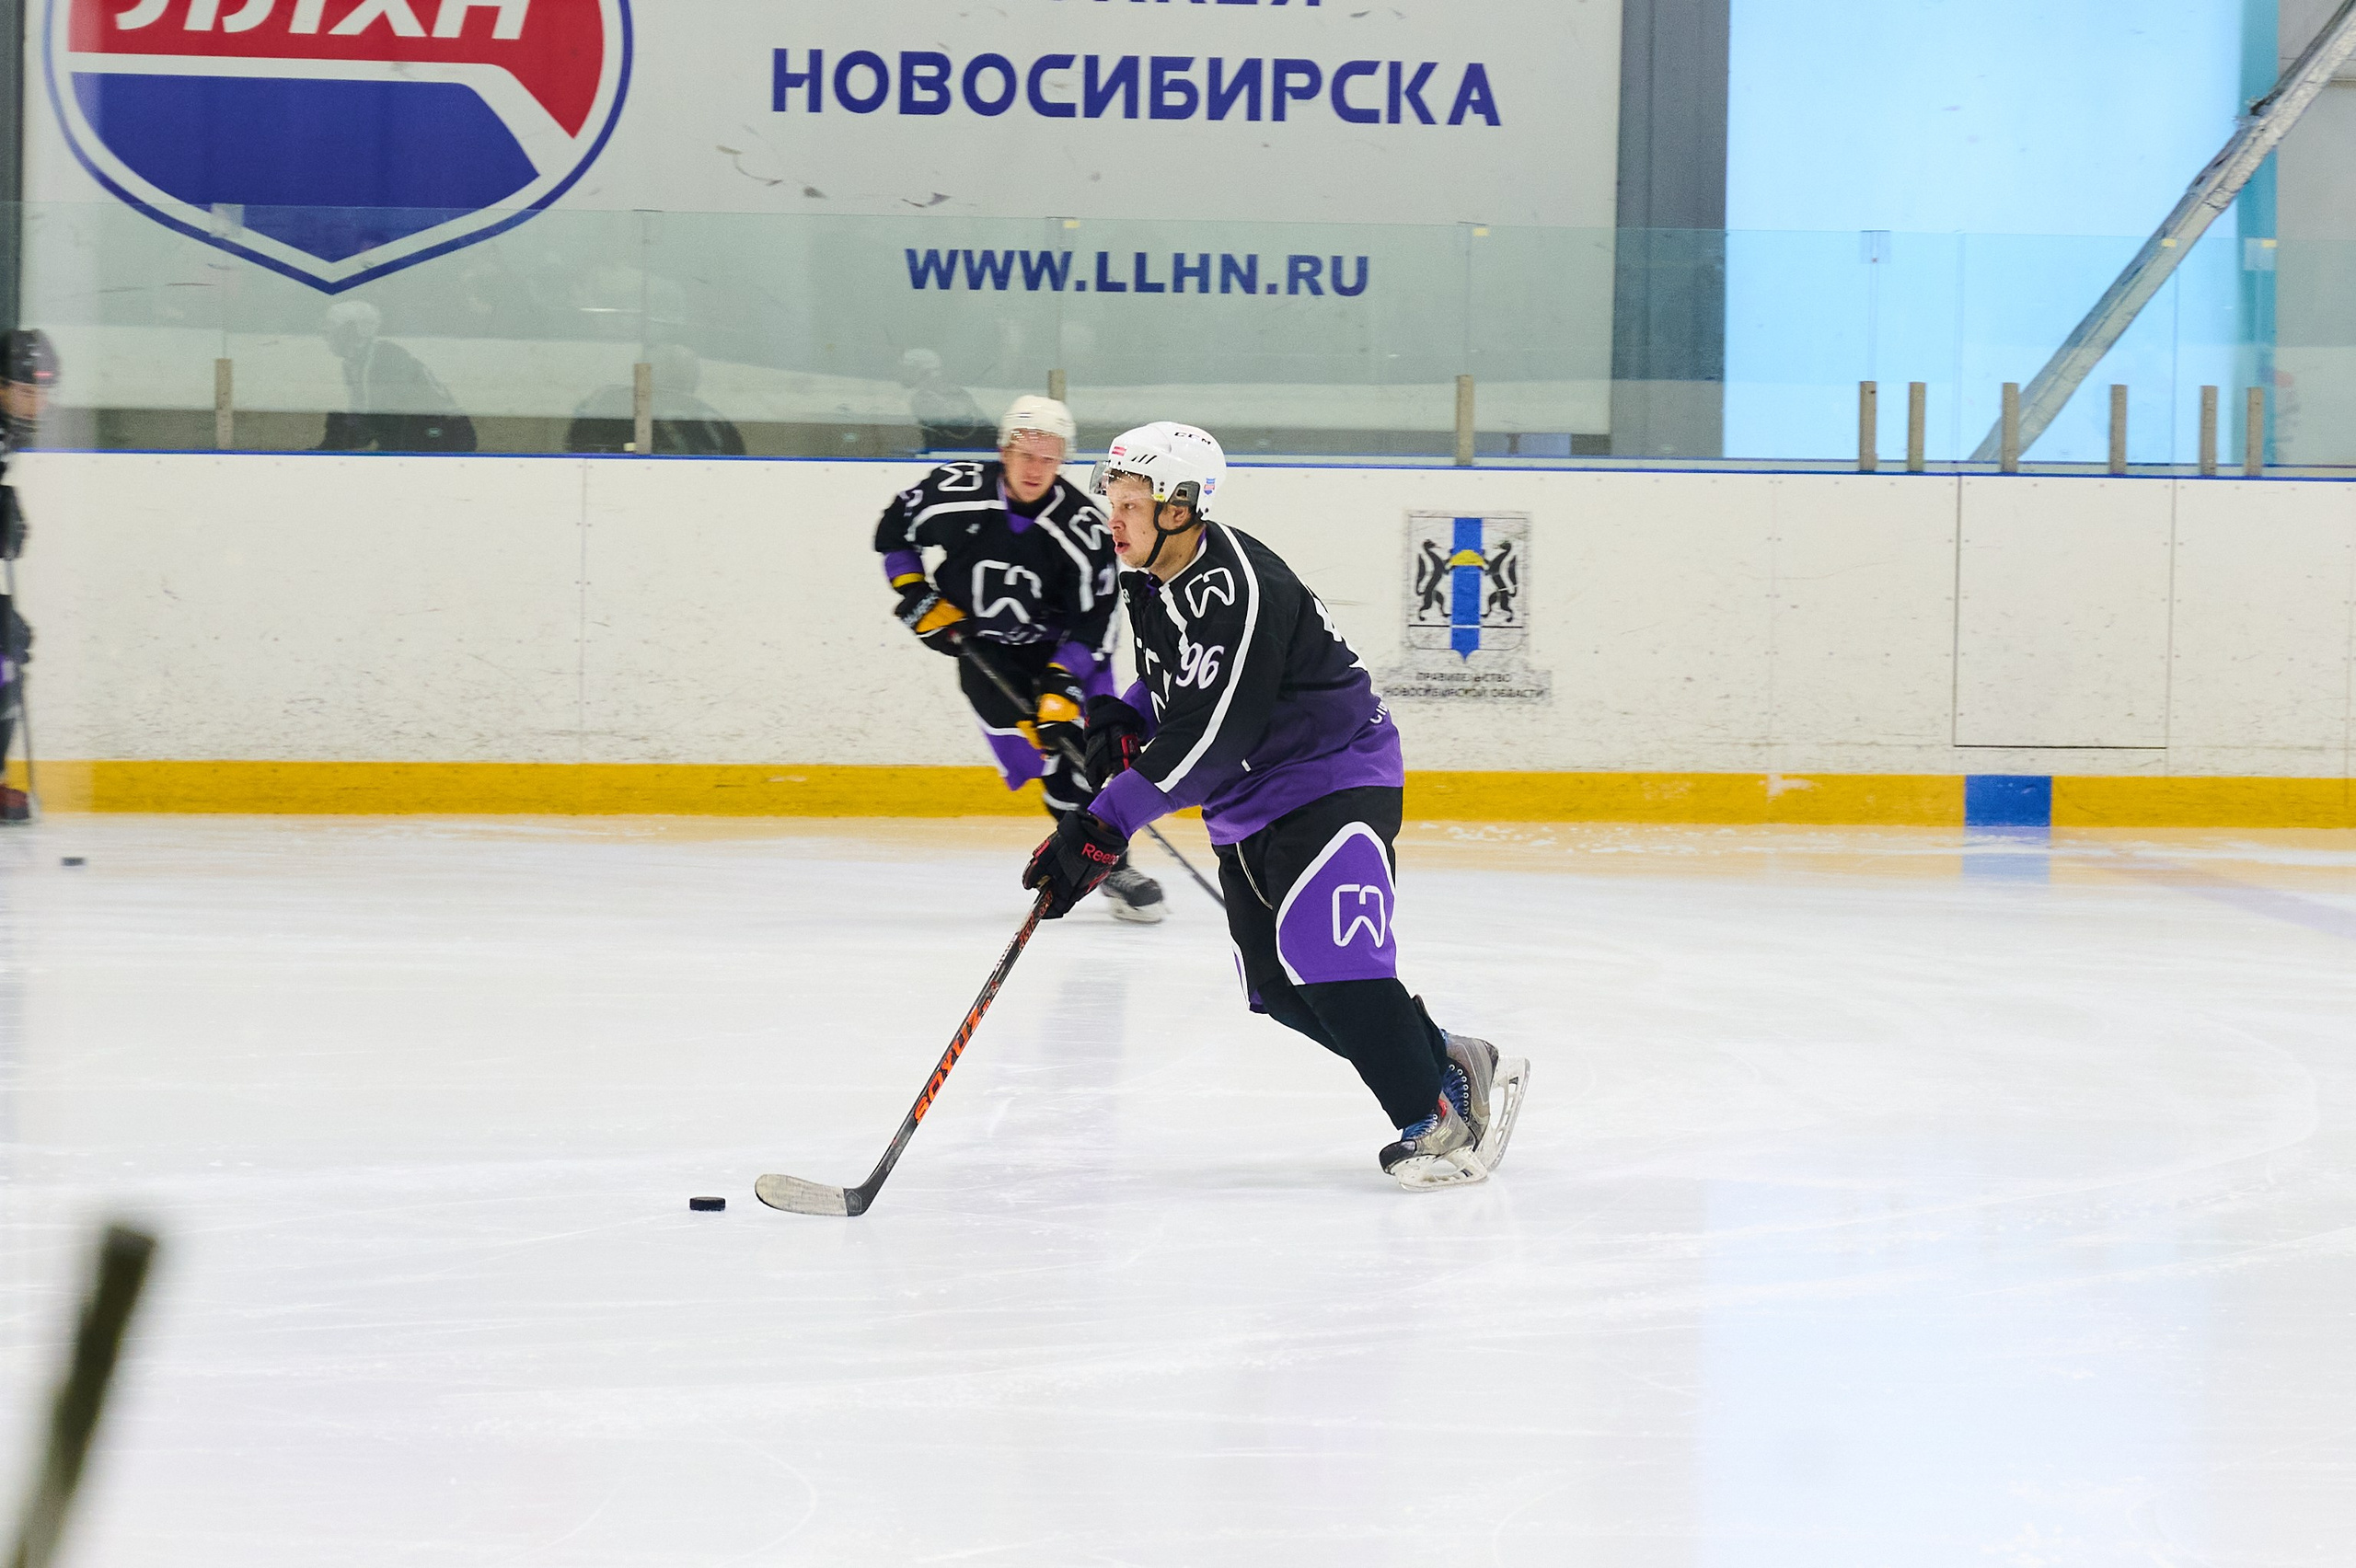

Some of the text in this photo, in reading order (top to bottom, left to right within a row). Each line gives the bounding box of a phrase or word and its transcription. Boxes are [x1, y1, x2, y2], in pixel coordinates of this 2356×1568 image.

[770, 48, 1502, 127] НОВОСИБИРСКА
[905, 247, 1370, 297] WWW.LLHN.RU
[1175, 641, 1225, 690] 96
